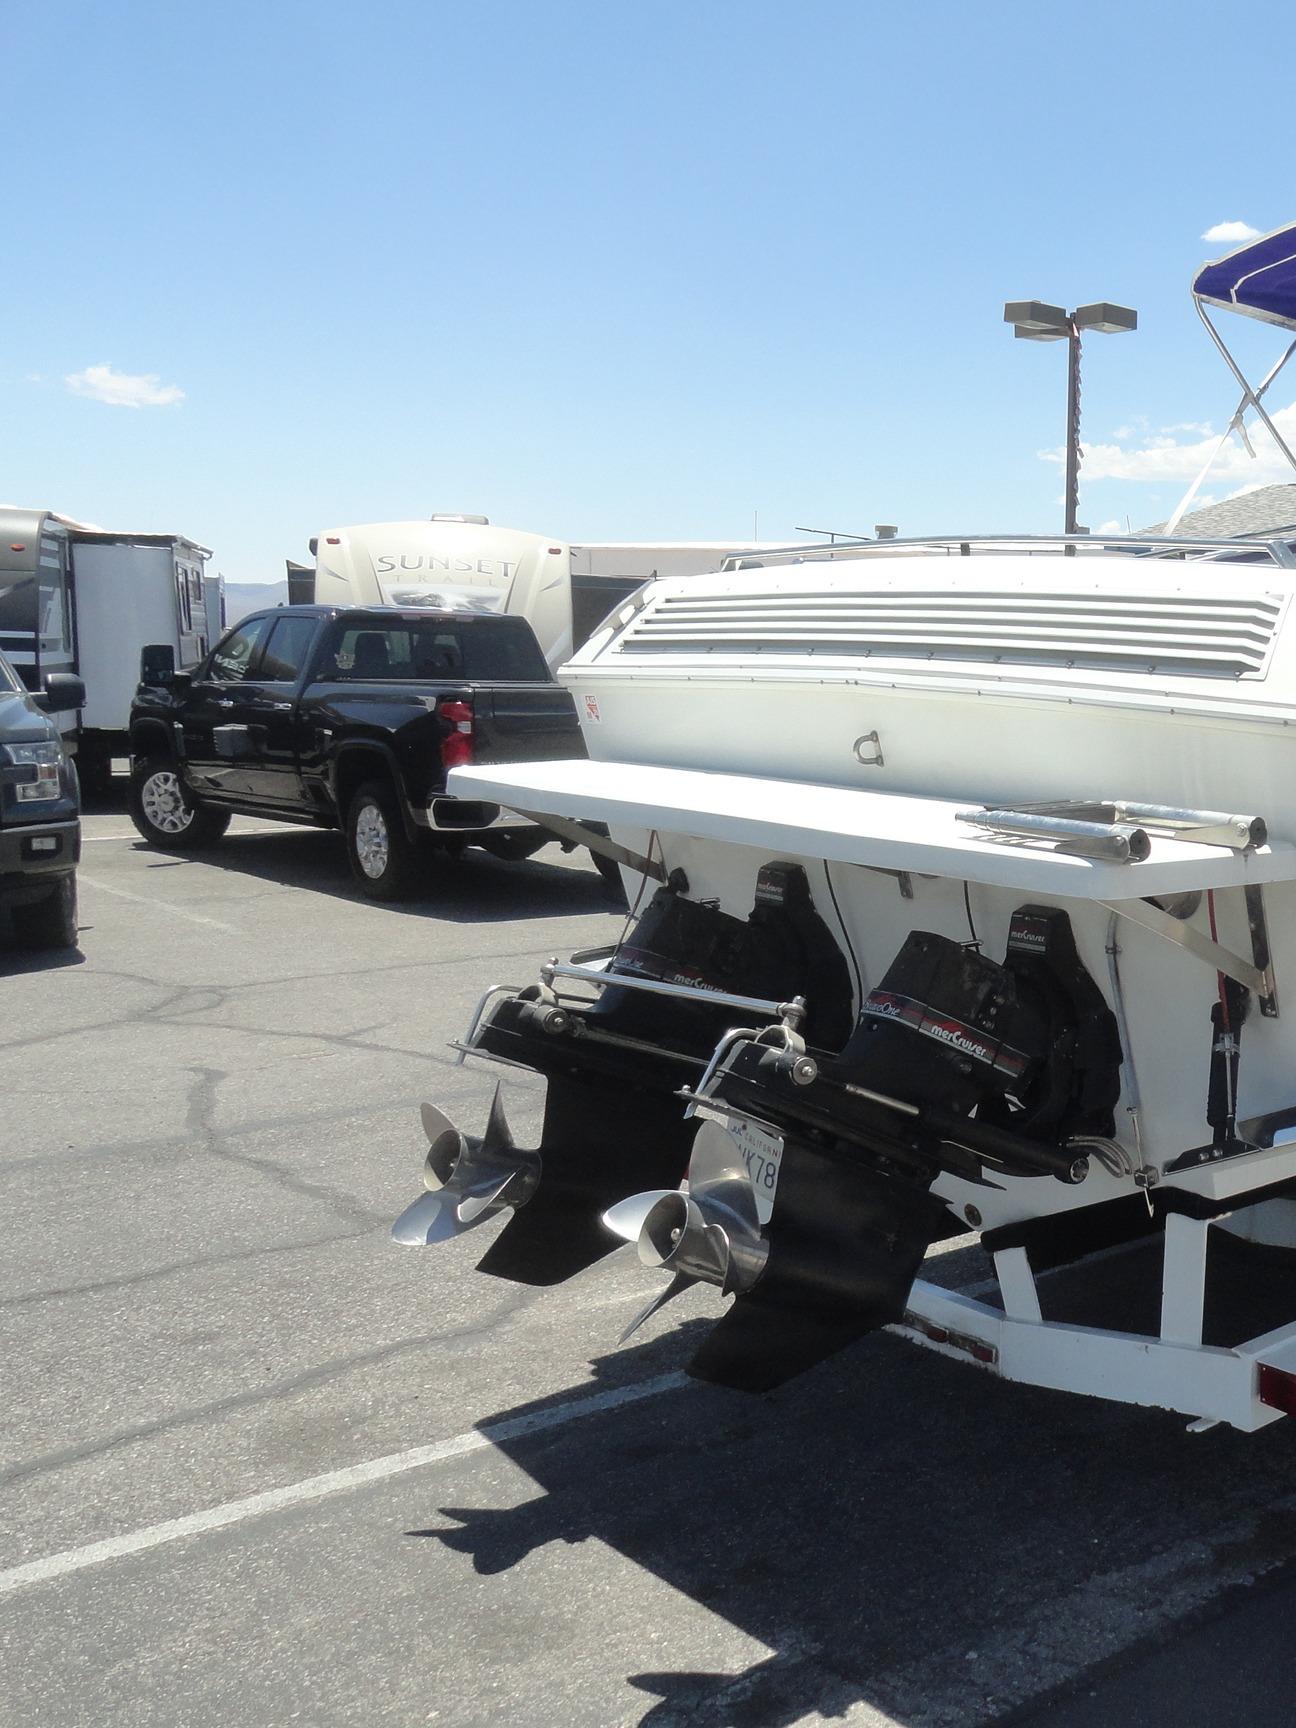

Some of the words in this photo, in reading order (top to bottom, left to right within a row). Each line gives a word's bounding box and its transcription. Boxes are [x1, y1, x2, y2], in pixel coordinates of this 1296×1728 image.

[377, 555, 516, 577] SUNSET
[394, 574, 498, 587] TRAIL
[931, 1024, 987, 1057] merCruiser
